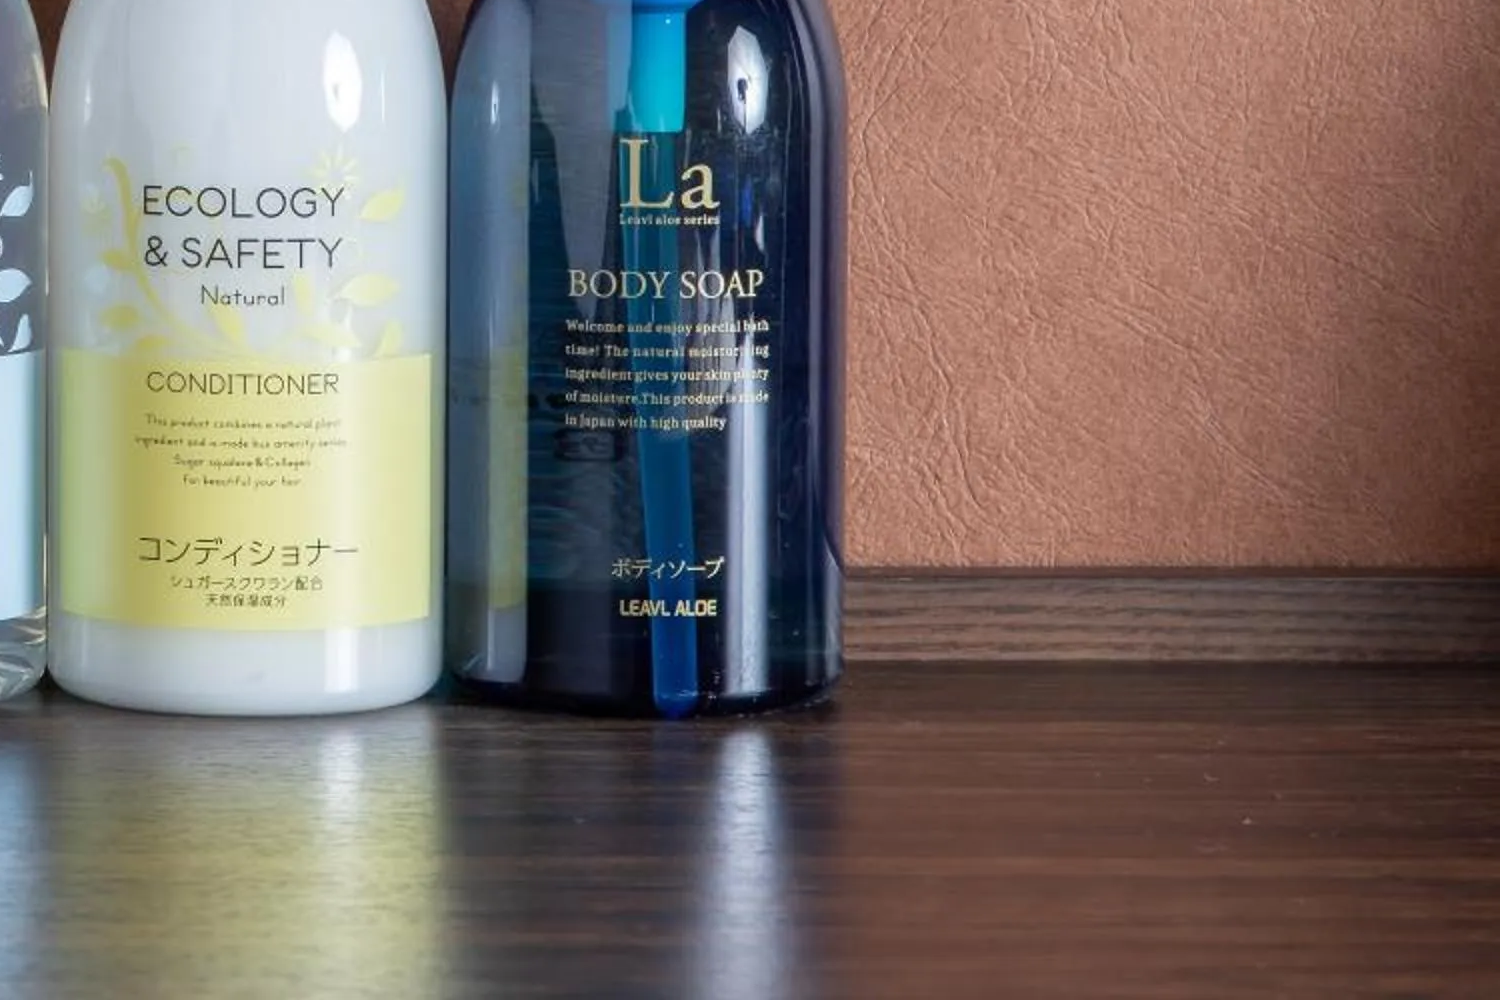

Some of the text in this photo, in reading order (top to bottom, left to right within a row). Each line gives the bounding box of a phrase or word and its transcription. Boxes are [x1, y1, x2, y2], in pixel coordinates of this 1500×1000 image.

[619, 138, 721, 210] La
[143, 185, 344, 218] ECOLOGY
[144, 235, 343, 269] & SAFETY
[200, 284, 286, 306] Natural
[568, 269, 764, 299] BODY SOAP
[565, 319, 625, 333] Welcome
[627, 321, 653, 333] and
[655, 322, 692, 337] enjoy
[695, 320, 741, 336] special
[603, 344, 629, 357] The
[632, 345, 684, 357] natural
[688, 344, 770, 359] moisturiing
[146, 371, 339, 395] CONDITIONER
[634, 369, 669, 384] gives
[671, 371, 702, 385] your
[565, 390, 579, 403] of
[673, 392, 724, 407] product
[617, 415, 647, 429] with
[650, 416, 679, 431] high
[681, 414, 727, 432] quality
[138, 536, 358, 567] コンディショナー
[611, 556, 725, 579] ボディソープ
[620, 599, 717, 617] LEAVL ALOE
